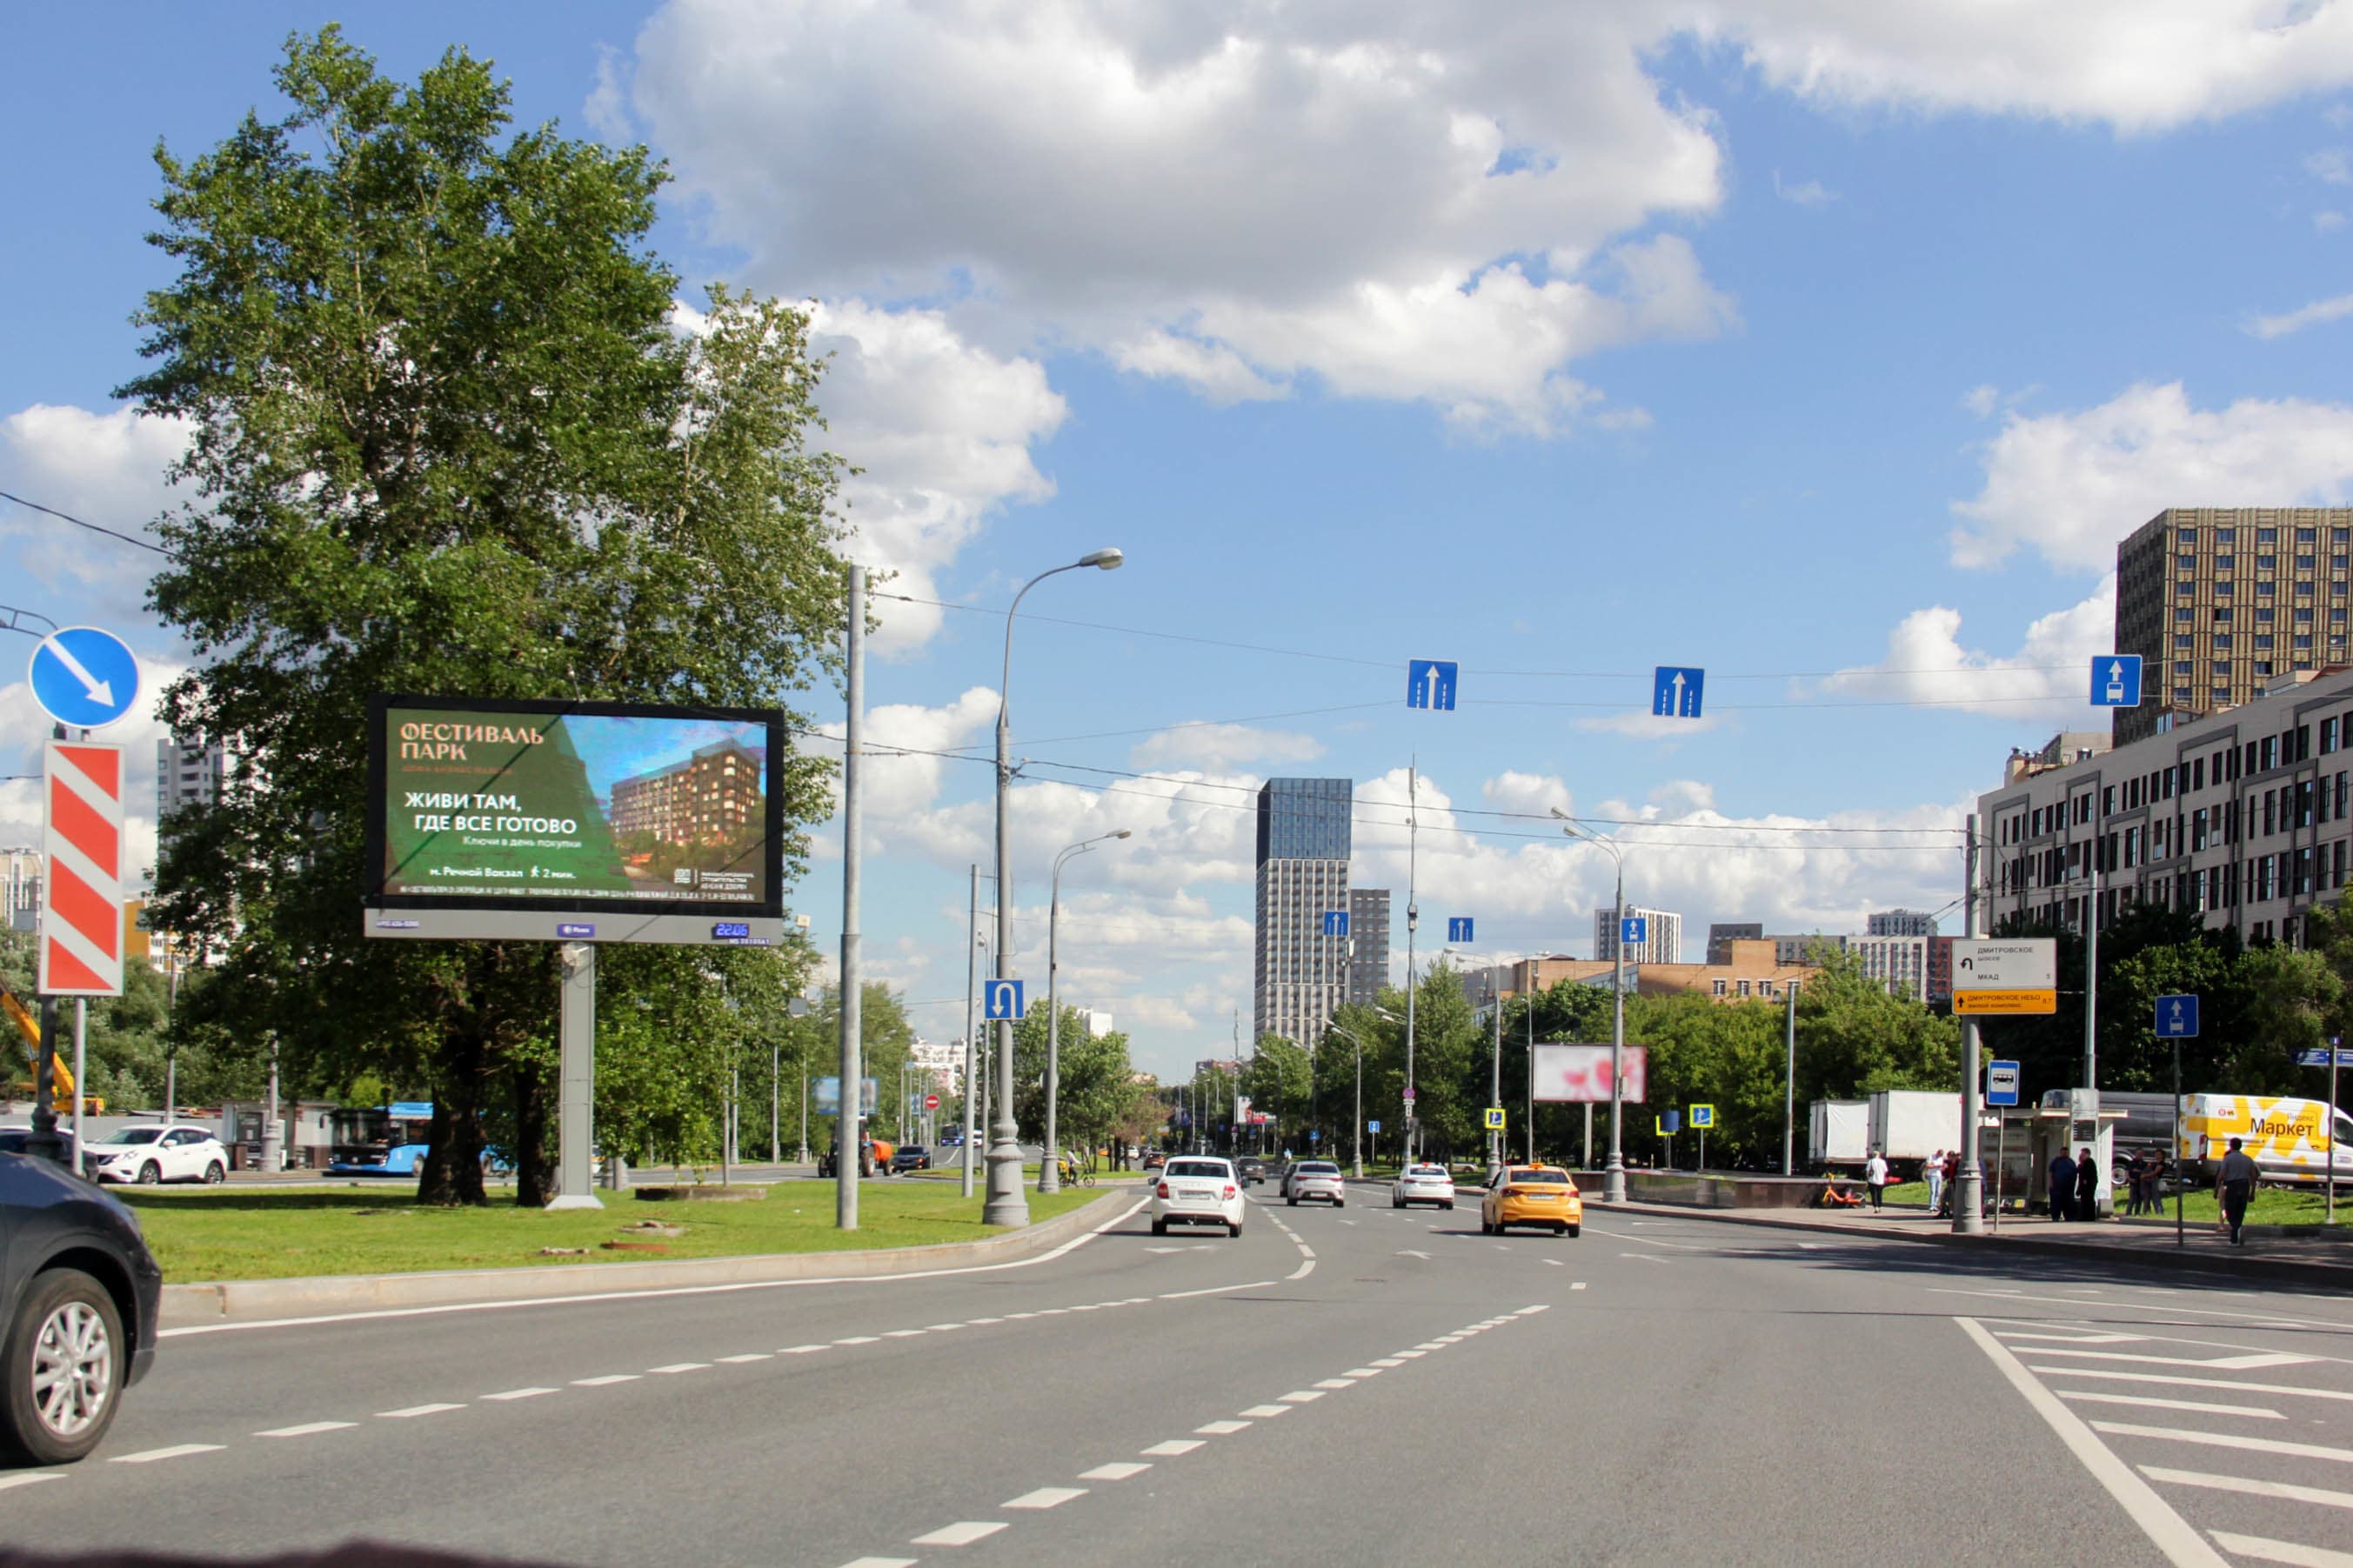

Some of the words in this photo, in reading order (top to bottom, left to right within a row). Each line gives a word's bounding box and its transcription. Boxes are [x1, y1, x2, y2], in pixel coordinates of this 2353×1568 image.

[399, 722, 544, 745] ФЕСТИВАЛЬ
[400, 741, 467, 761] ПАРК
[404, 791, 469, 809] ЖИВИ
[473, 793, 522, 812] ТАМ,
[414, 814, 451, 832] ГДЕ
[454, 816, 492, 831] ВСЕ
[497, 817, 578, 835] ГОТОВО
[462, 836, 499, 846] Ключи
[509, 838, 535, 847] день
[537, 840, 583, 850] покупки
[443, 865, 483, 877] Речной
[485, 867, 524, 878] Вокзал
[542, 869, 551, 878] 2
[1977, 946, 2034, 955] ДМИТРОВСКОЕ
[2249, 1118, 2314, 1137] Маркет
